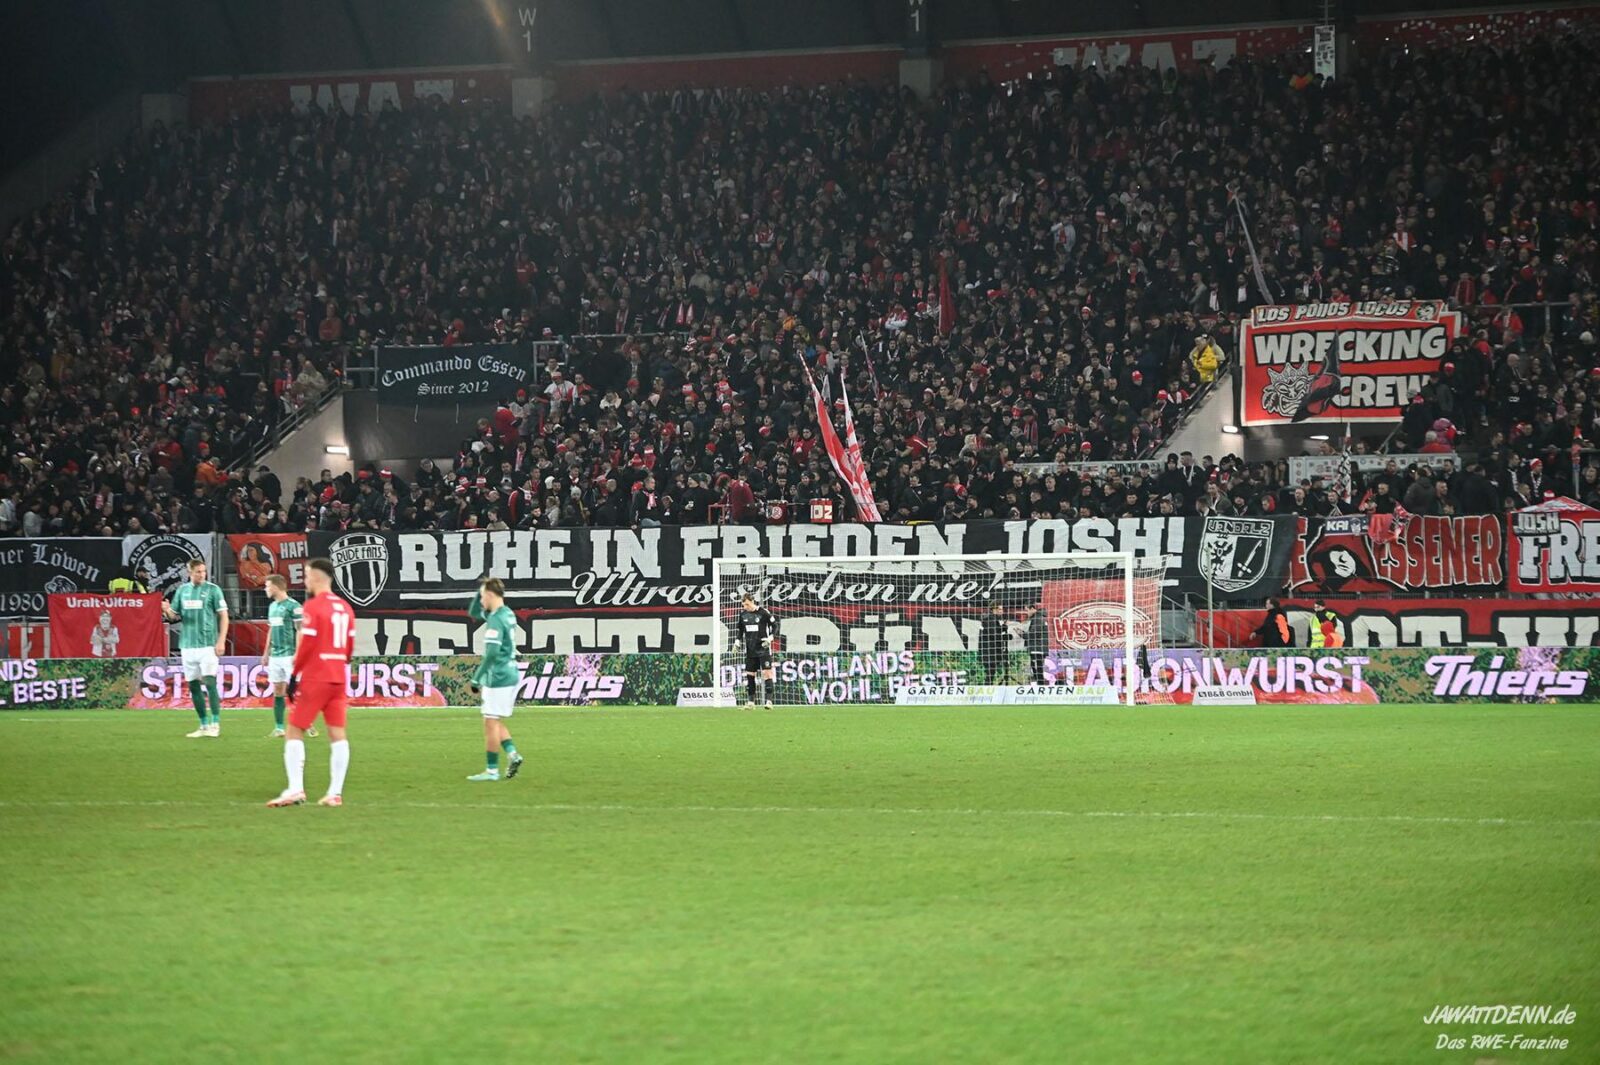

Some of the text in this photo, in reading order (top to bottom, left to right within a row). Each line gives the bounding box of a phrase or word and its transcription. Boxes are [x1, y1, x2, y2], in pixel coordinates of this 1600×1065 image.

[518, 8, 537, 26] W
[910, 9, 920, 32] 1
[522, 30, 531, 51] 1
[1257, 308, 1289, 323] LOS
[1355, 301, 1411, 317] LOCOS
[1253, 326, 1447, 365] WRECKING
[381, 355, 527, 387] Commando Essen
[417, 381, 489, 396] Since 2012
[1326, 520, 1349, 531] KAI
[279, 540, 309, 559] HAF
[337, 546, 383, 563] RUDE FANS
[398, 516, 1185, 582] RUHE IN FRIEDEN JOSH!
[30, 543, 100, 582] Löwen
[571, 568, 1004, 606] Ultras sterben nie!
[0, 592, 45, 612] 1980
[66, 597, 144, 609] Uralt-Ultras
[330, 612, 349, 649] 11
[1054, 616, 1154, 646] WESTTRIBNE
[142, 663, 440, 700] STDIOURST
[513, 660, 625, 701] hiers
[721, 650, 915, 688] DETSCHLANDS
[1425, 654, 1590, 697] Thiers
[13, 676, 86, 704] BESTE
[803, 678, 879, 704] WOHL
[907, 685, 995, 696] GARTENBAU
[1015, 685, 1105, 696] GARTENBAU
